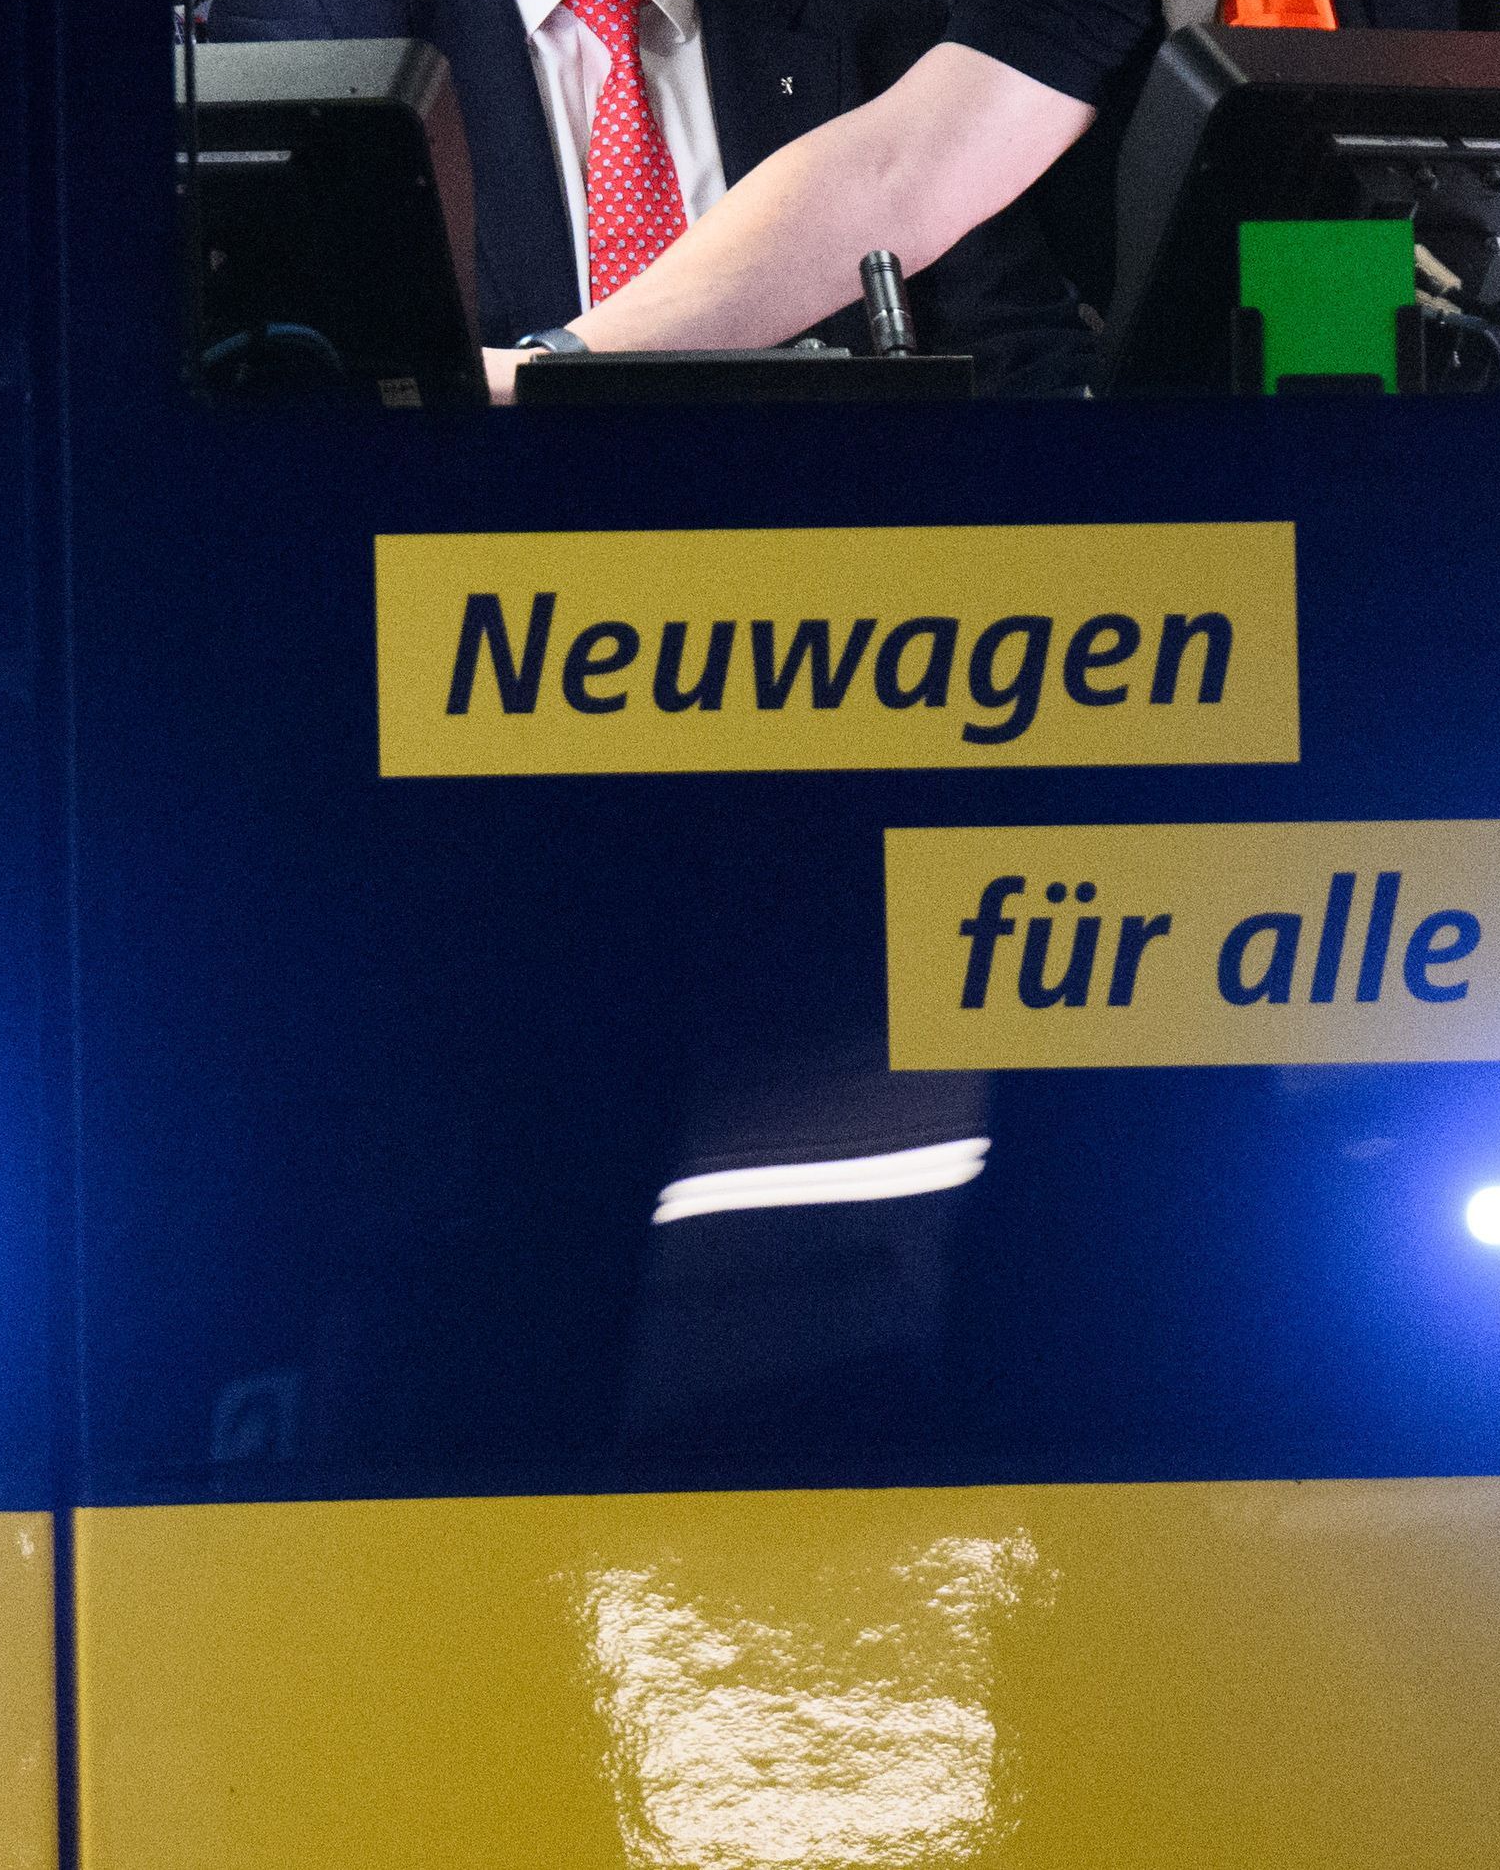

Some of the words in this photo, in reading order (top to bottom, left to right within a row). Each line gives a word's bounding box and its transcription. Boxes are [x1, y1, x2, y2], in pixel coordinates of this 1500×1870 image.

[445, 591, 1235, 746] Neuwagen
[959, 874, 1173, 1011] für
[1216, 870, 1483, 1008] alle
